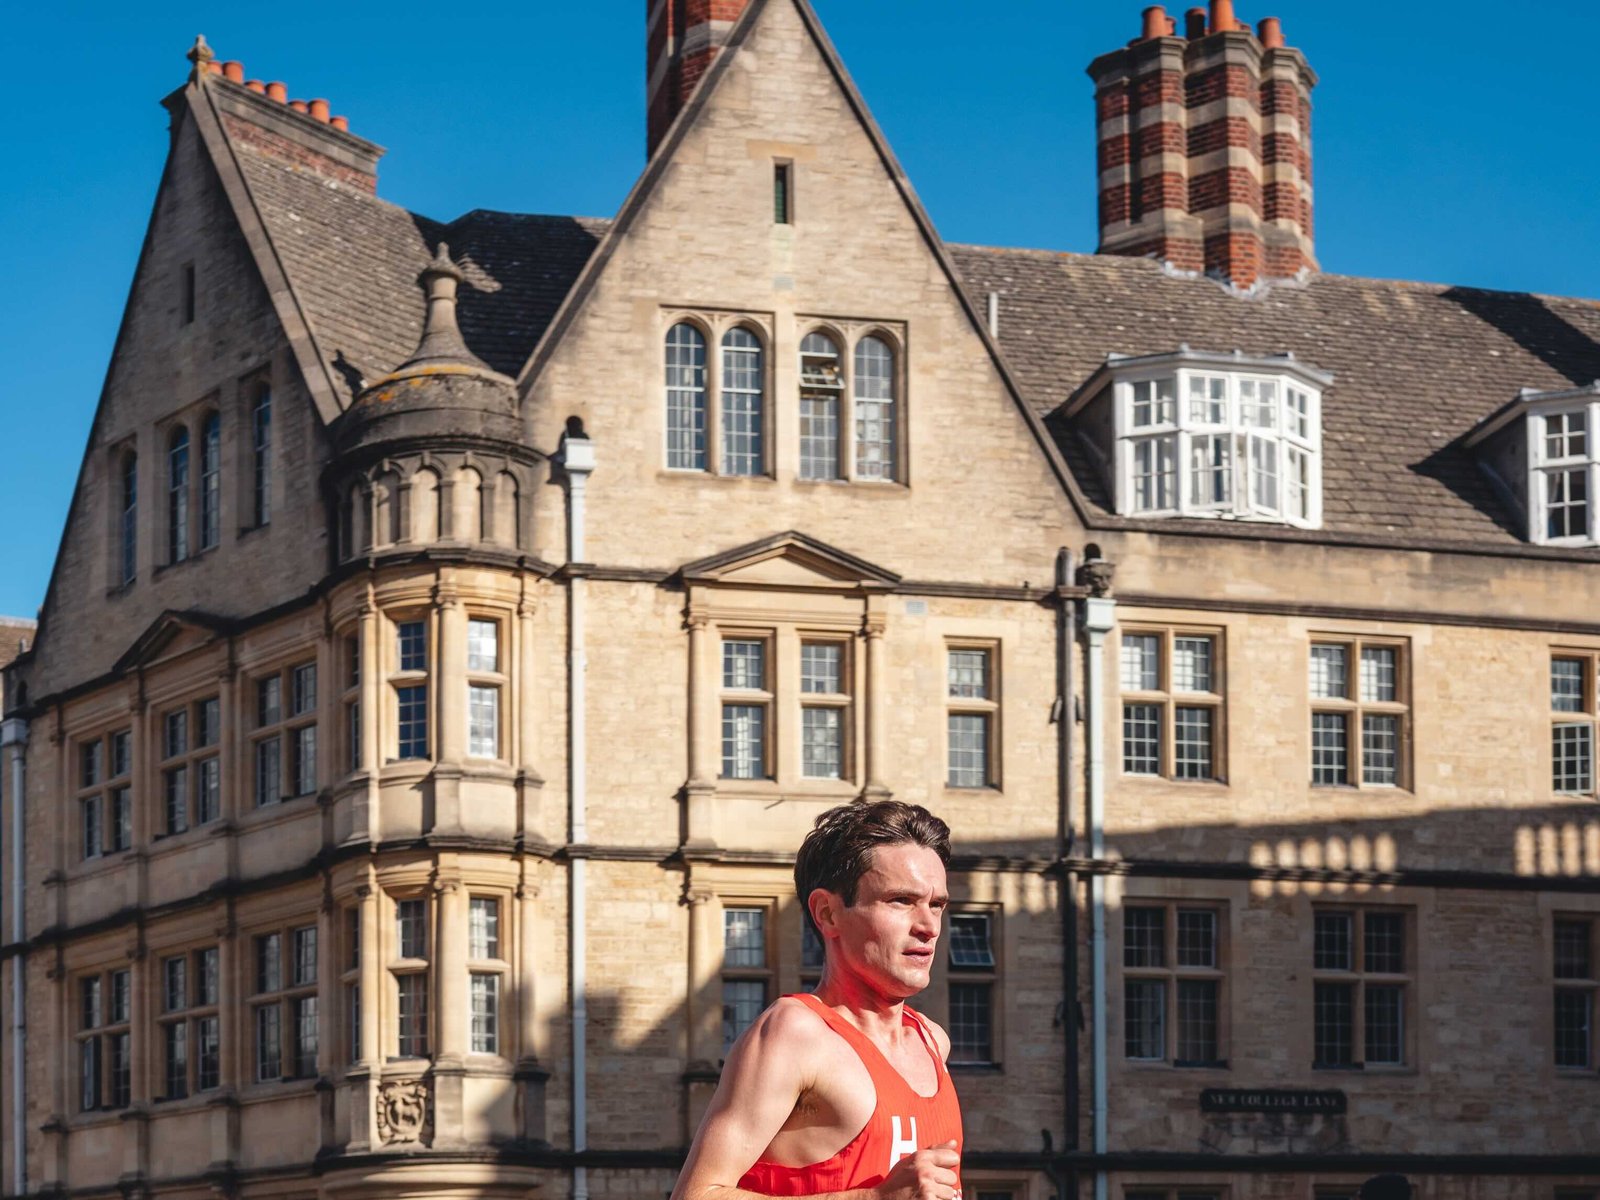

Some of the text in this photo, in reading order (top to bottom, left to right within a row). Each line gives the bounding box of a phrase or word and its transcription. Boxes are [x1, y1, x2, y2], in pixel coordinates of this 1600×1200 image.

[1209, 1094, 1337, 1107] NEW COLLEGE LANE
